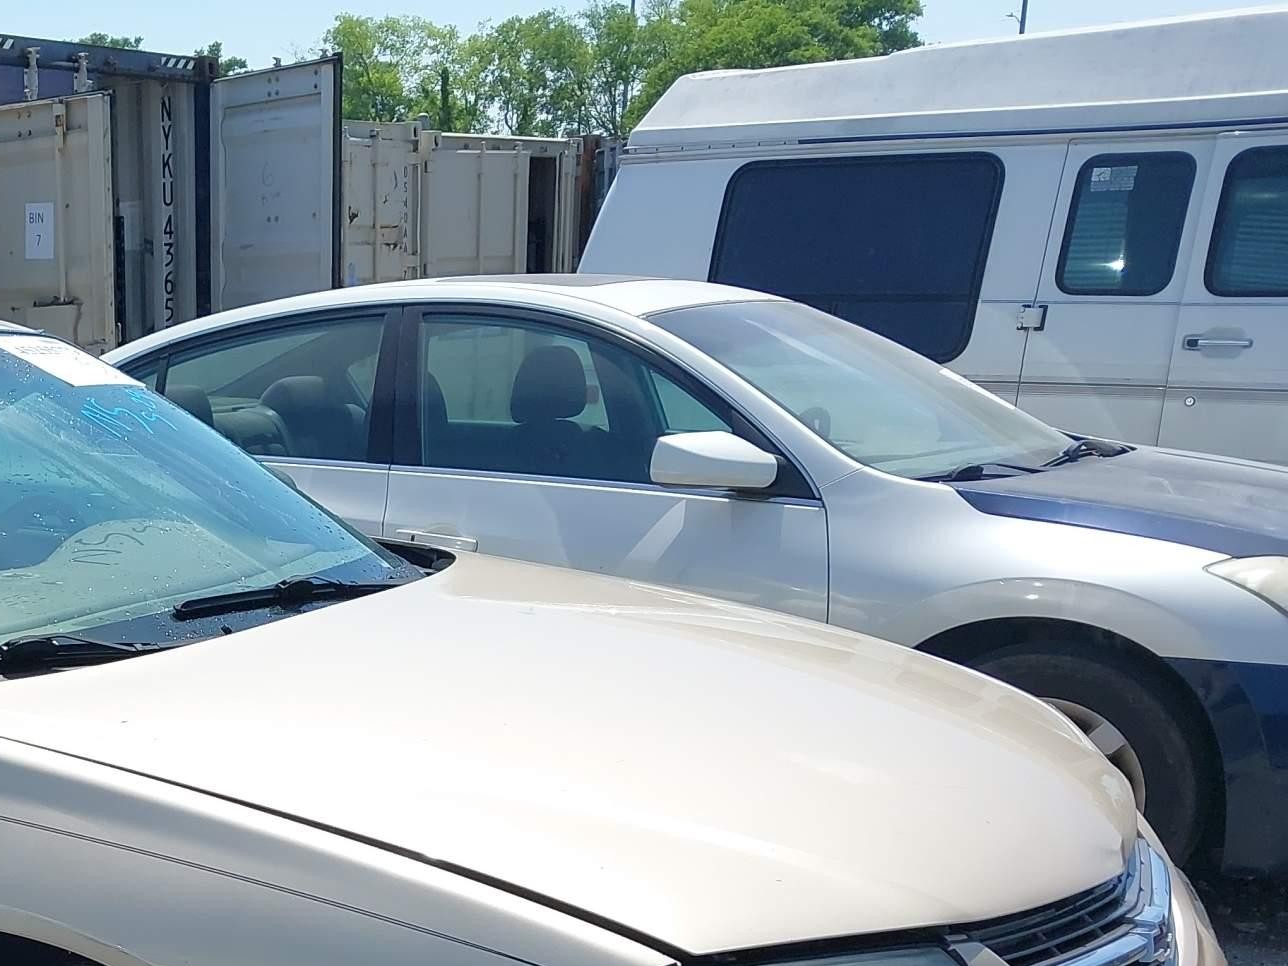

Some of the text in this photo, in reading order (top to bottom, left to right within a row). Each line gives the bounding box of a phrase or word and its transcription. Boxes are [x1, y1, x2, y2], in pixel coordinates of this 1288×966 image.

[161, 96, 174, 207] NYKU
[28, 211, 44, 225] BIN
[34, 233, 42, 247] 7
